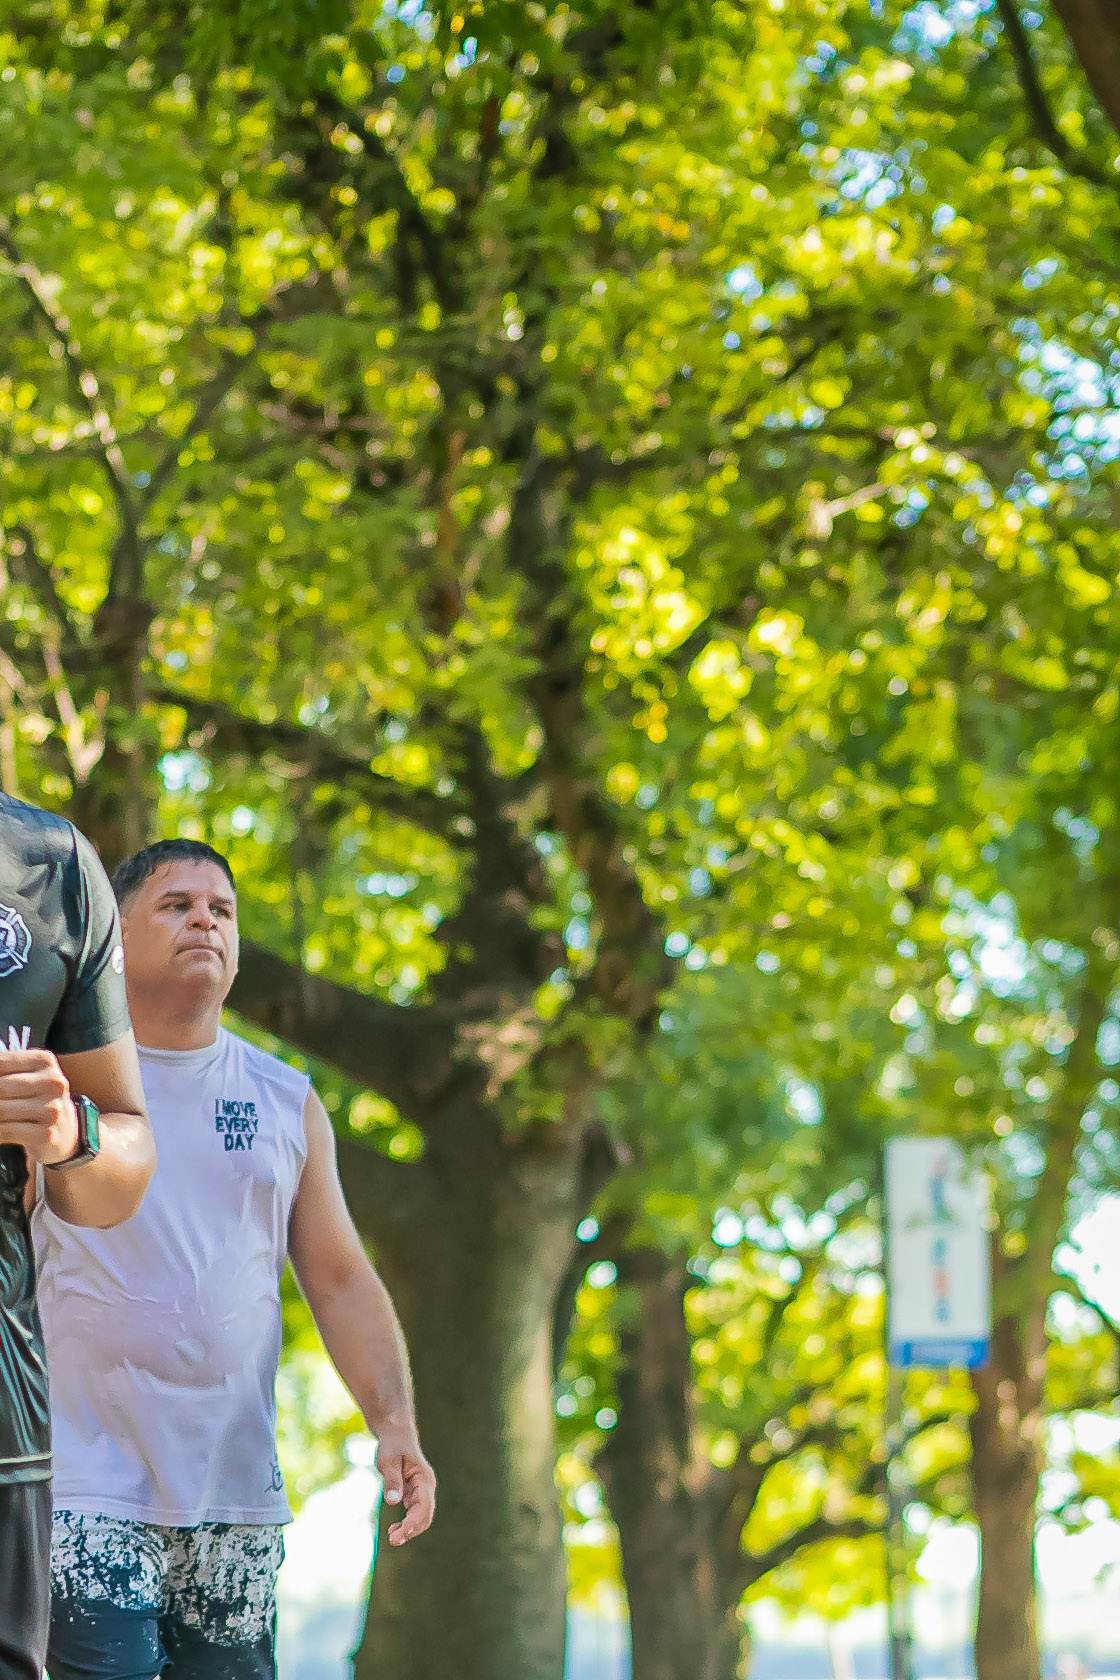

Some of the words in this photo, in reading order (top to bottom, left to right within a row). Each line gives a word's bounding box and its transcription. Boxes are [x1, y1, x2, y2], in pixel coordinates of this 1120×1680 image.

[215, 1099, 219, 1115] I
[222, 1098, 258, 1117] MOVE
[215, 1116, 259, 1133] EVERY
[224, 1133, 254, 1151] DAY
